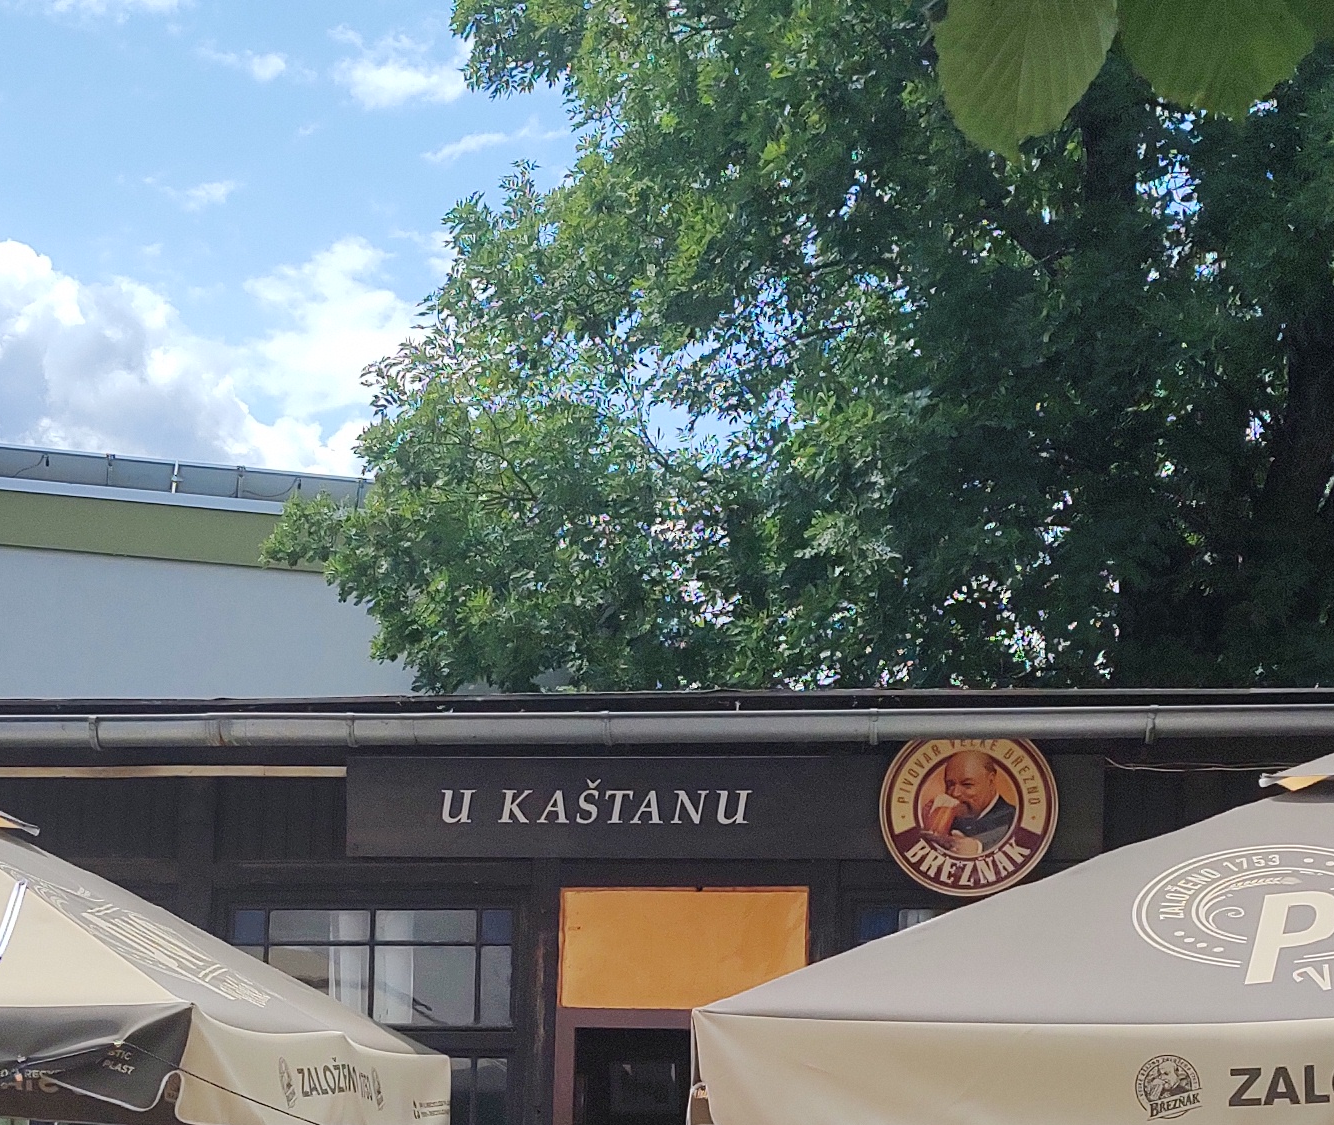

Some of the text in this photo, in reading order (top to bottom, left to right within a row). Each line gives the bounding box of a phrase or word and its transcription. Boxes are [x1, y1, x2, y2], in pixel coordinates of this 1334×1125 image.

[441, 778, 753, 825] U KAŠTANU
[897, 743, 942, 804] PIVOVAR
[905, 836, 1031, 887] BŘEZŇÁK
[1159, 854, 1280, 920] ZALOŽENO 1753
